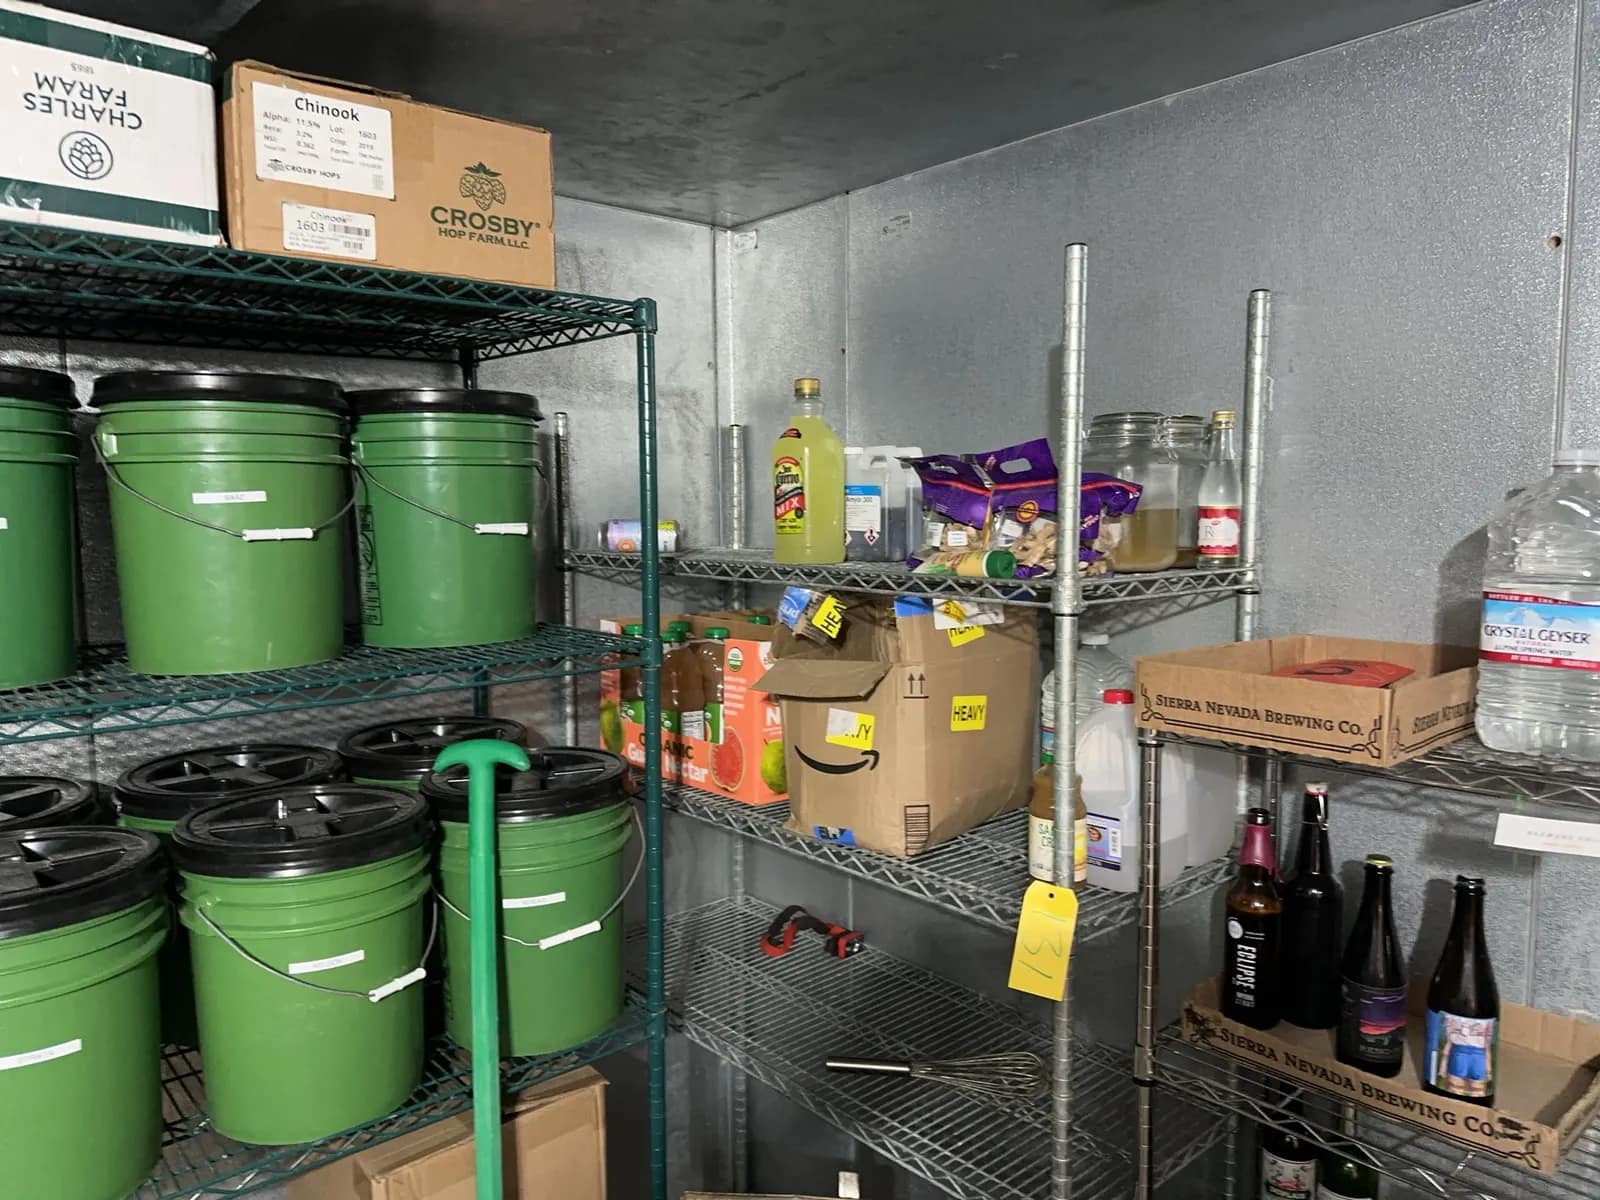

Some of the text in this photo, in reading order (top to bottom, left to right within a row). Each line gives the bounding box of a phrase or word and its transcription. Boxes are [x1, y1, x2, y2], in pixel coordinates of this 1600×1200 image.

[34, 72, 127, 107] FARAM
[23, 92, 143, 130] CHARLES
[263, 111, 321, 129] Alpha: 11.5%
[294, 97, 360, 122] Chinook
[329, 124, 377, 141] Lot: 1603
[285, 164, 342, 180] CROSBY HOPS
[296, 219, 325, 233] 1603
[310, 210, 347, 223] Chinook
[438, 227, 466, 240] HOP
[775, 496, 802, 518] MIX
[1484, 624, 1591, 645] CRYSTAL GEYSER
[953, 704, 984, 722] HEAVY
[1155, 694, 1202, 713] SIERRA
[1205, 700, 1260, 721] NEVADA
[1264, 709, 1334, 731] BREWING
[1235, 943, 1257, 990] ECLIPSE
[1219, 1027, 1279, 1063] SIERRA
[1283, 1050, 1356, 1092] NEVADA
[1359, 1080, 1457, 1127] BREWING
